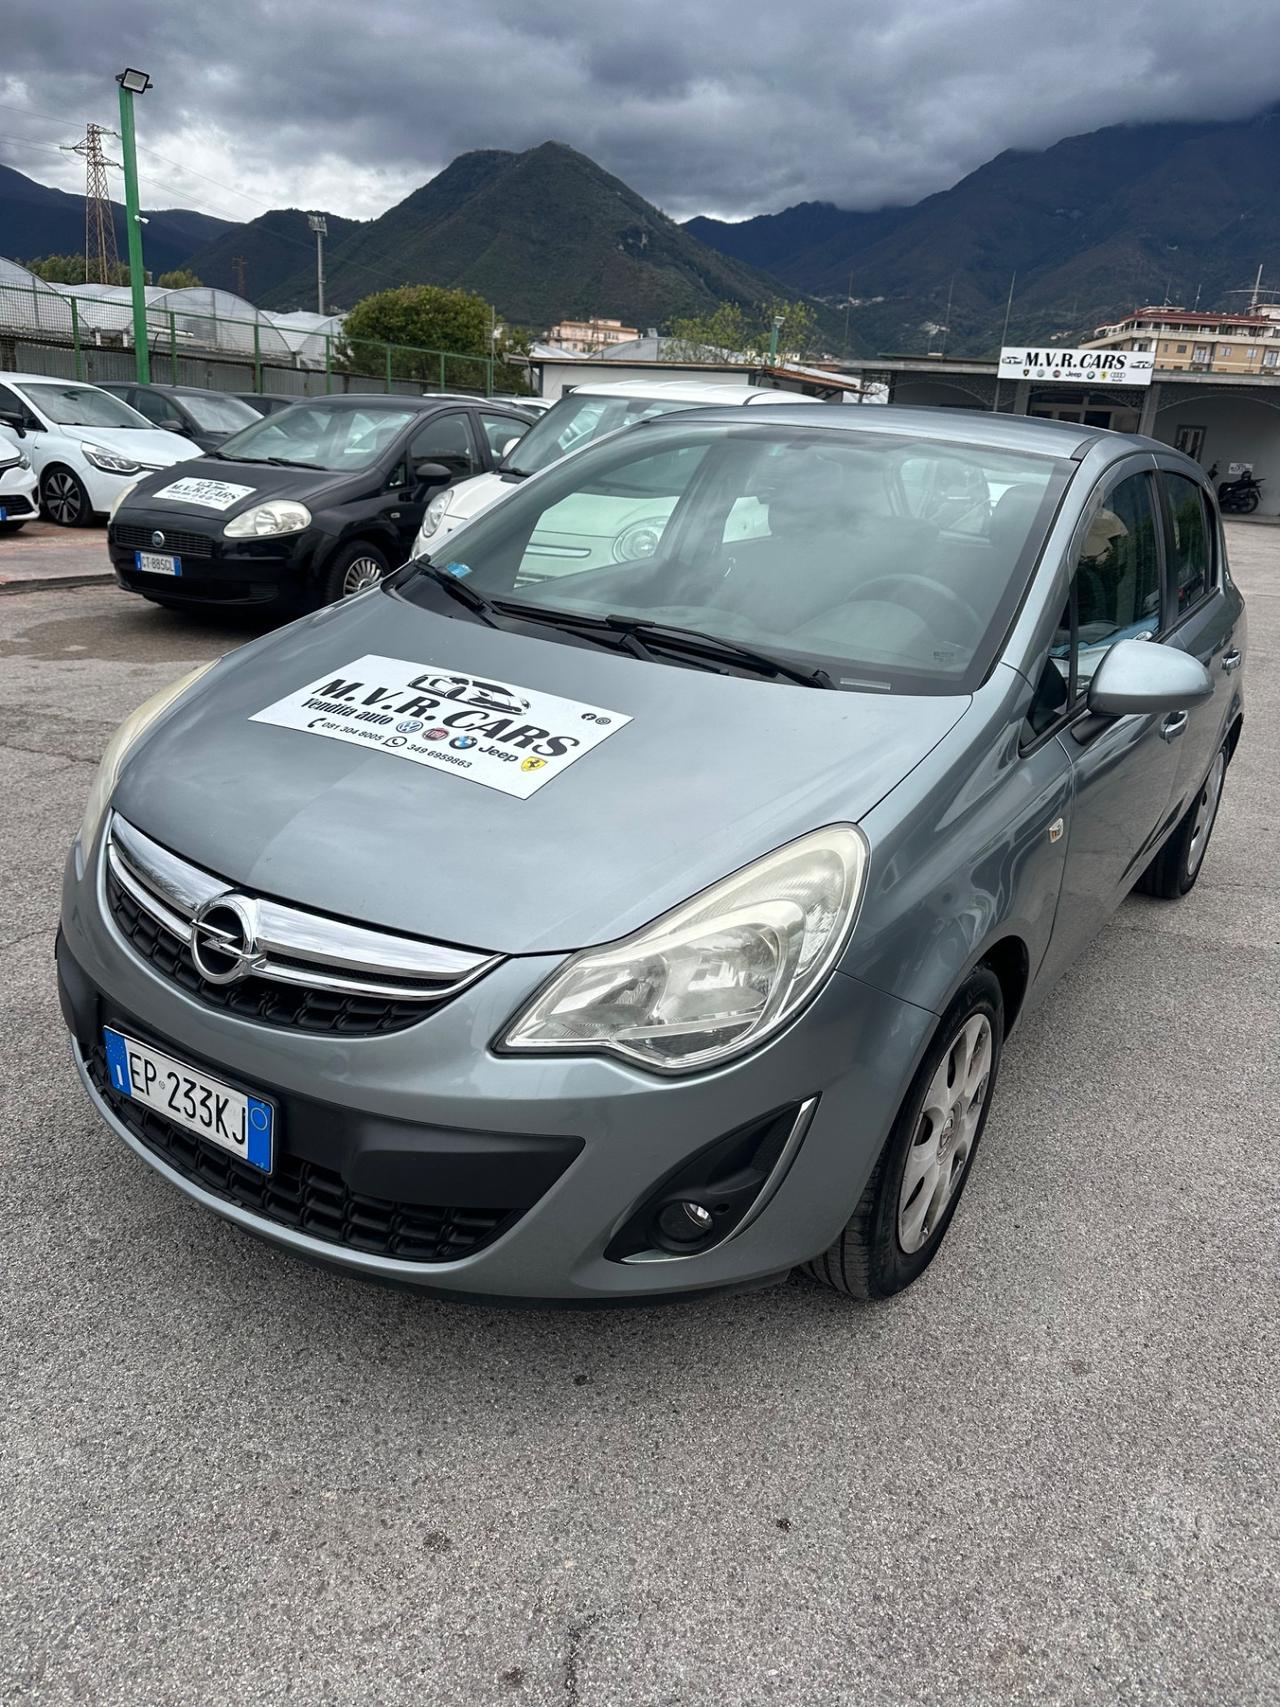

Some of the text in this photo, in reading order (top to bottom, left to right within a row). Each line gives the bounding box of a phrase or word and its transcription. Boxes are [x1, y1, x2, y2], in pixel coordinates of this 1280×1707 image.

[301, 698, 394, 725] Vendita auto
[321, 722, 472, 768] 081 304 8005 349 6959863
[478, 744, 519, 763] Jeep
[129, 1051, 157, 1096] EP
[167, 1071, 246, 1145] 233KJ
